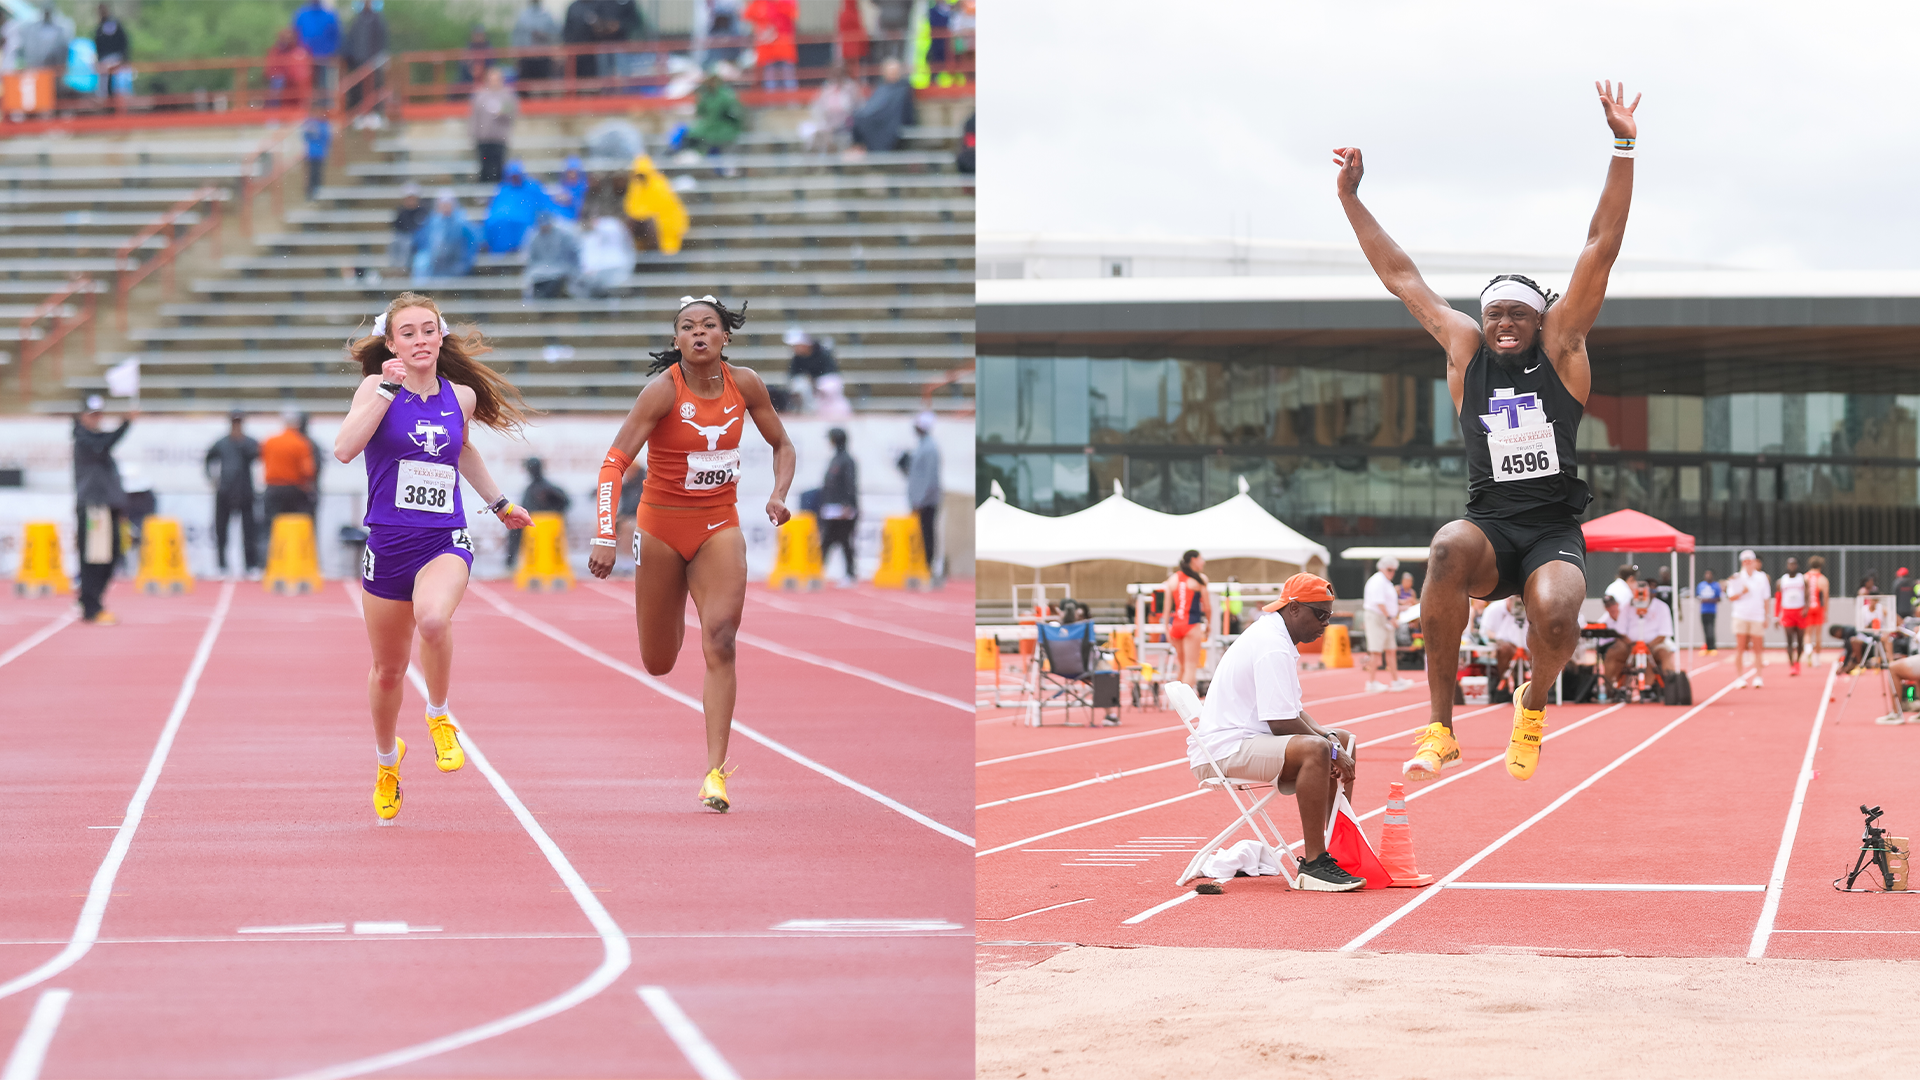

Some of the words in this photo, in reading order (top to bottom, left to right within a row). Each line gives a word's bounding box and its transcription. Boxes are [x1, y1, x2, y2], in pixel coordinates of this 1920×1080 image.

[680, 402, 696, 418] SEC
[1503, 435, 1527, 444] TEXAS
[1527, 432, 1553, 441] RELAYS
[1501, 450, 1549, 475] 4596
[413, 469, 435, 477] TEXAS
[404, 484, 446, 508] 3838
[599, 481, 613, 515] HOOK
[1523, 733, 1540, 742] PUMA
